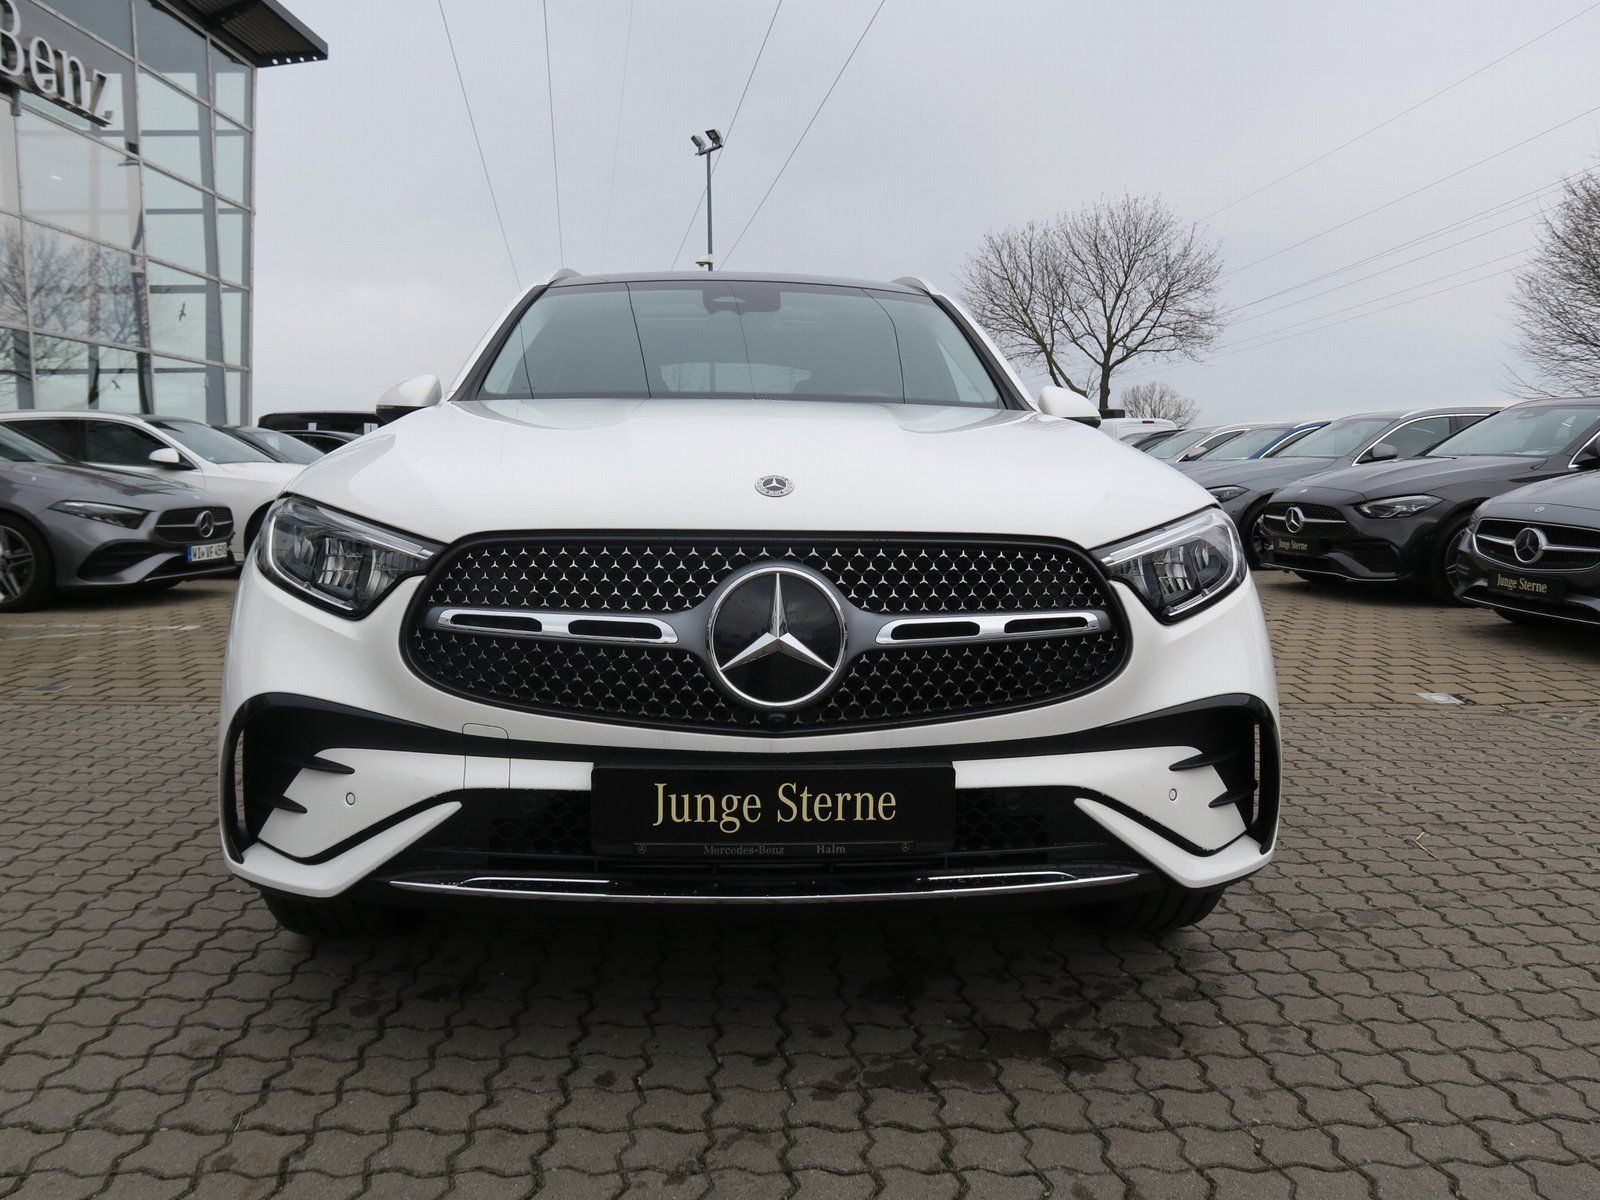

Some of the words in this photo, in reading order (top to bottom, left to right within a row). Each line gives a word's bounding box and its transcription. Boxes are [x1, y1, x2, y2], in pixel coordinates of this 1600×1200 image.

[1497, 573, 1517, 590] Junge
[1519, 577, 1548, 593] Sterne
[653, 783, 762, 833] Junge
[777, 782, 897, 822] Sterne
[703, 844, 785, 856] Mercedes-Benz
[816, 844, 846, 854] Halm
